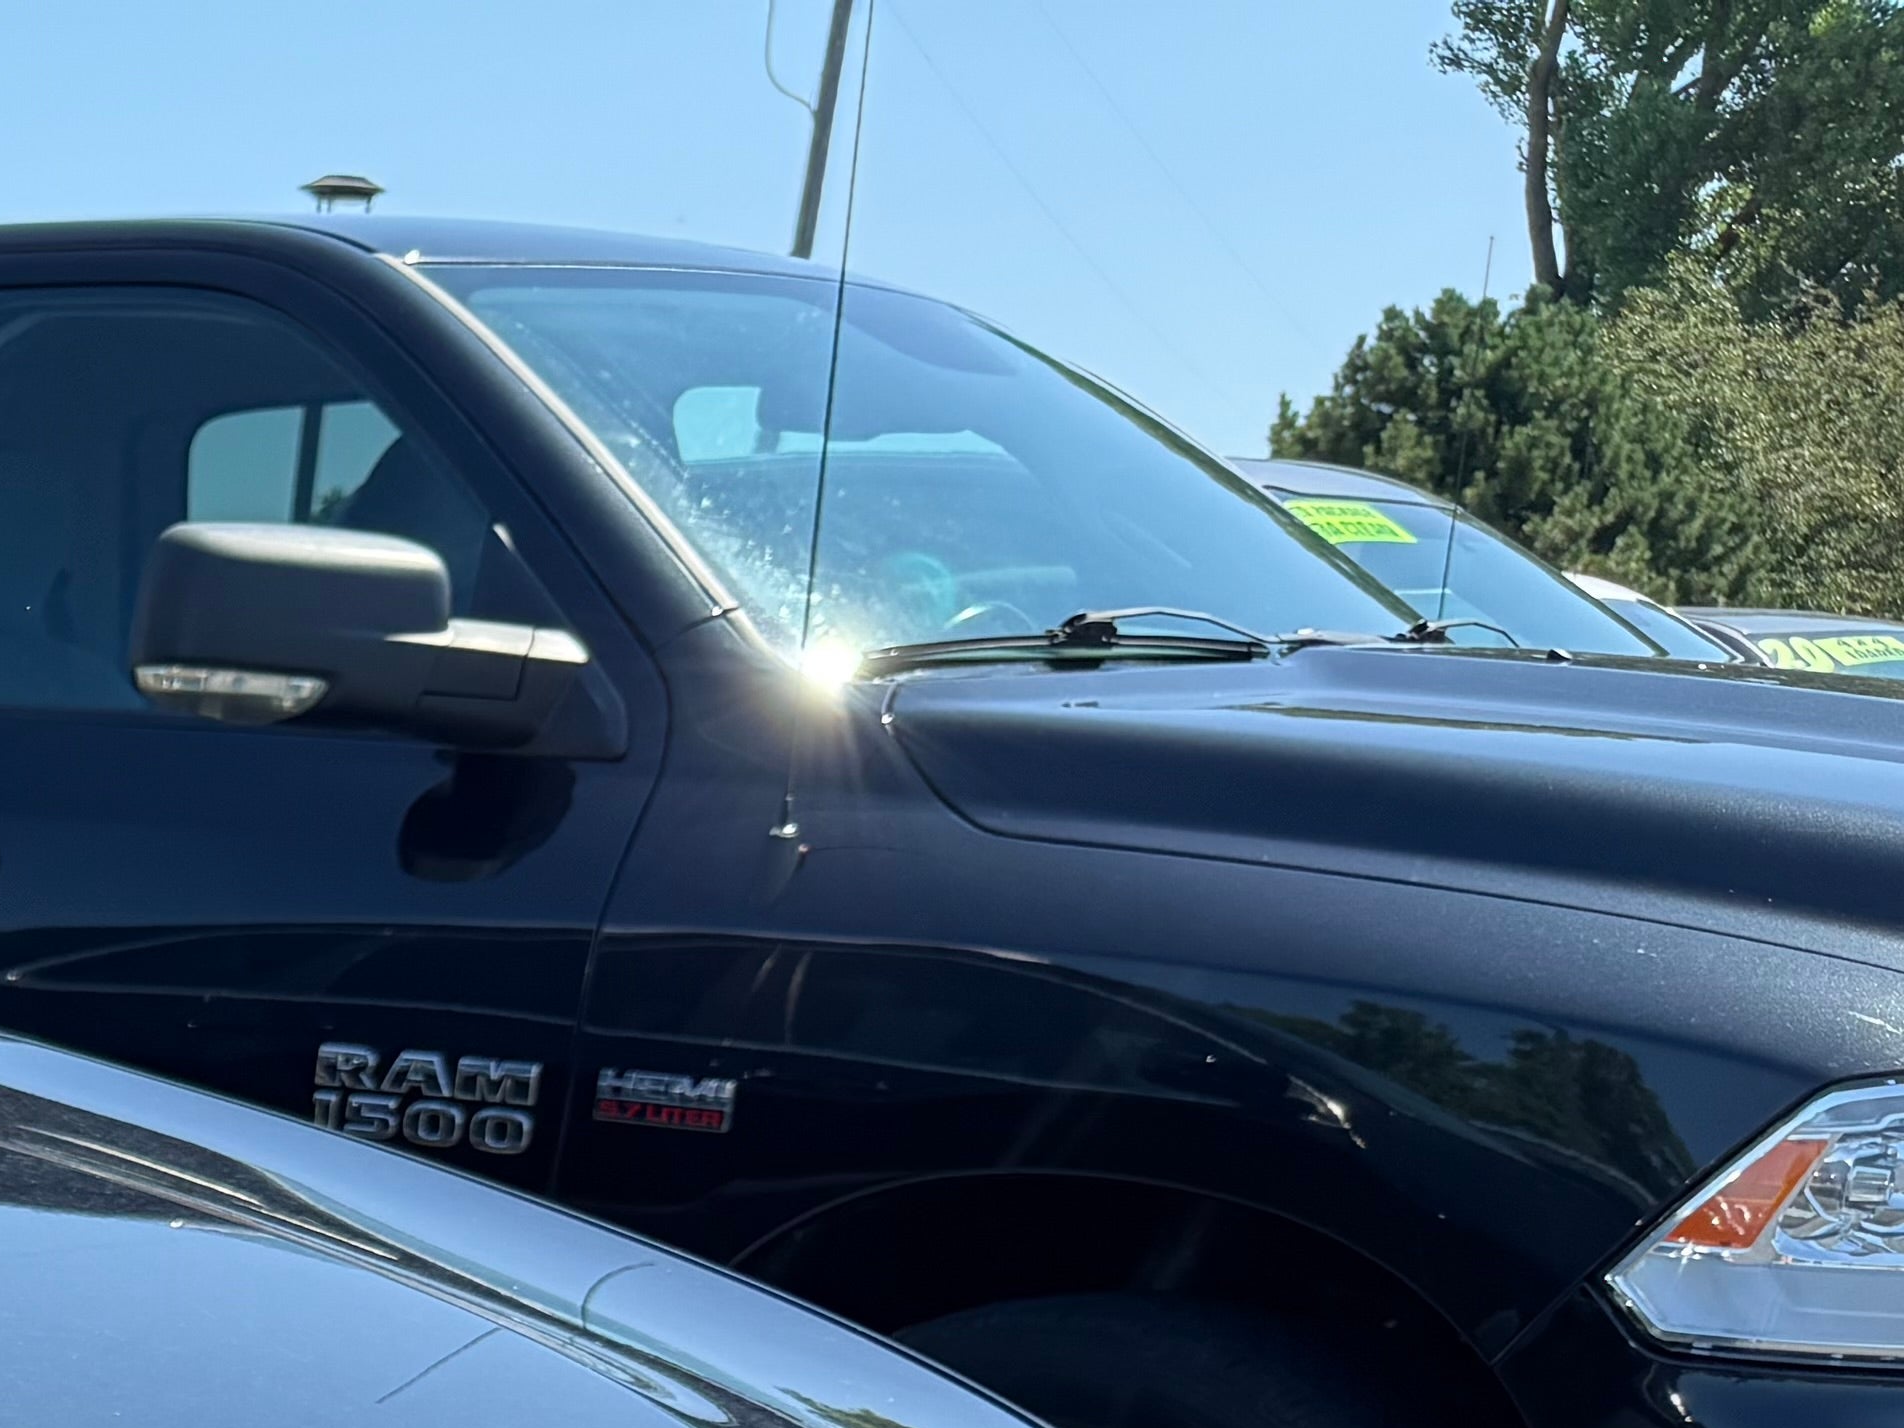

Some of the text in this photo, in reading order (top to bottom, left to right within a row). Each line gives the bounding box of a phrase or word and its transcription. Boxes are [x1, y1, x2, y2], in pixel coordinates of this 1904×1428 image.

[314, 1041, 544, 1107] RAM
[596, 1067, 738, 1103] HEMI
[312, 1088, 535, 1155] 1500
[644, 1104, 724, 1129] LITER
